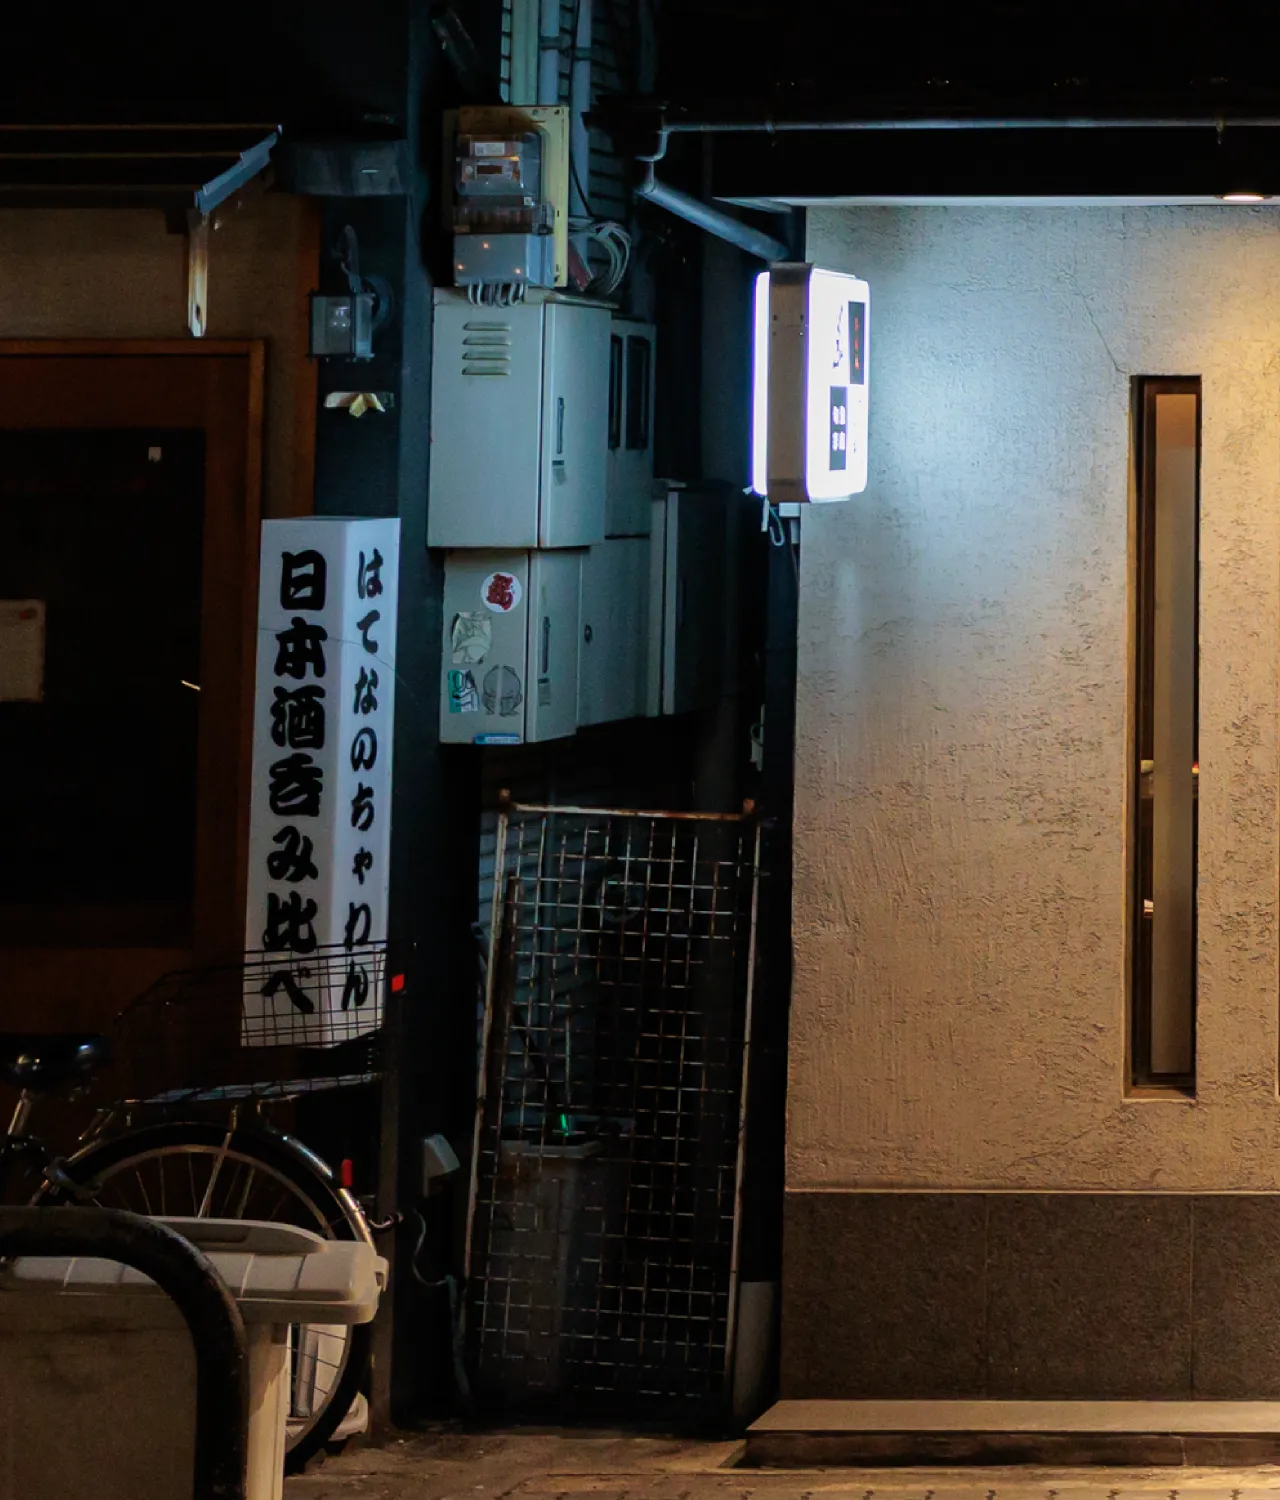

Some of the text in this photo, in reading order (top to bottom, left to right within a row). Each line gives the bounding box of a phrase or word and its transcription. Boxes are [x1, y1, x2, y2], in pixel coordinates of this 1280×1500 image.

[262, 549, 329, 1014] 日本酒呑み比べ
[342, 549, 385, 1012] はてなのちゃわん
